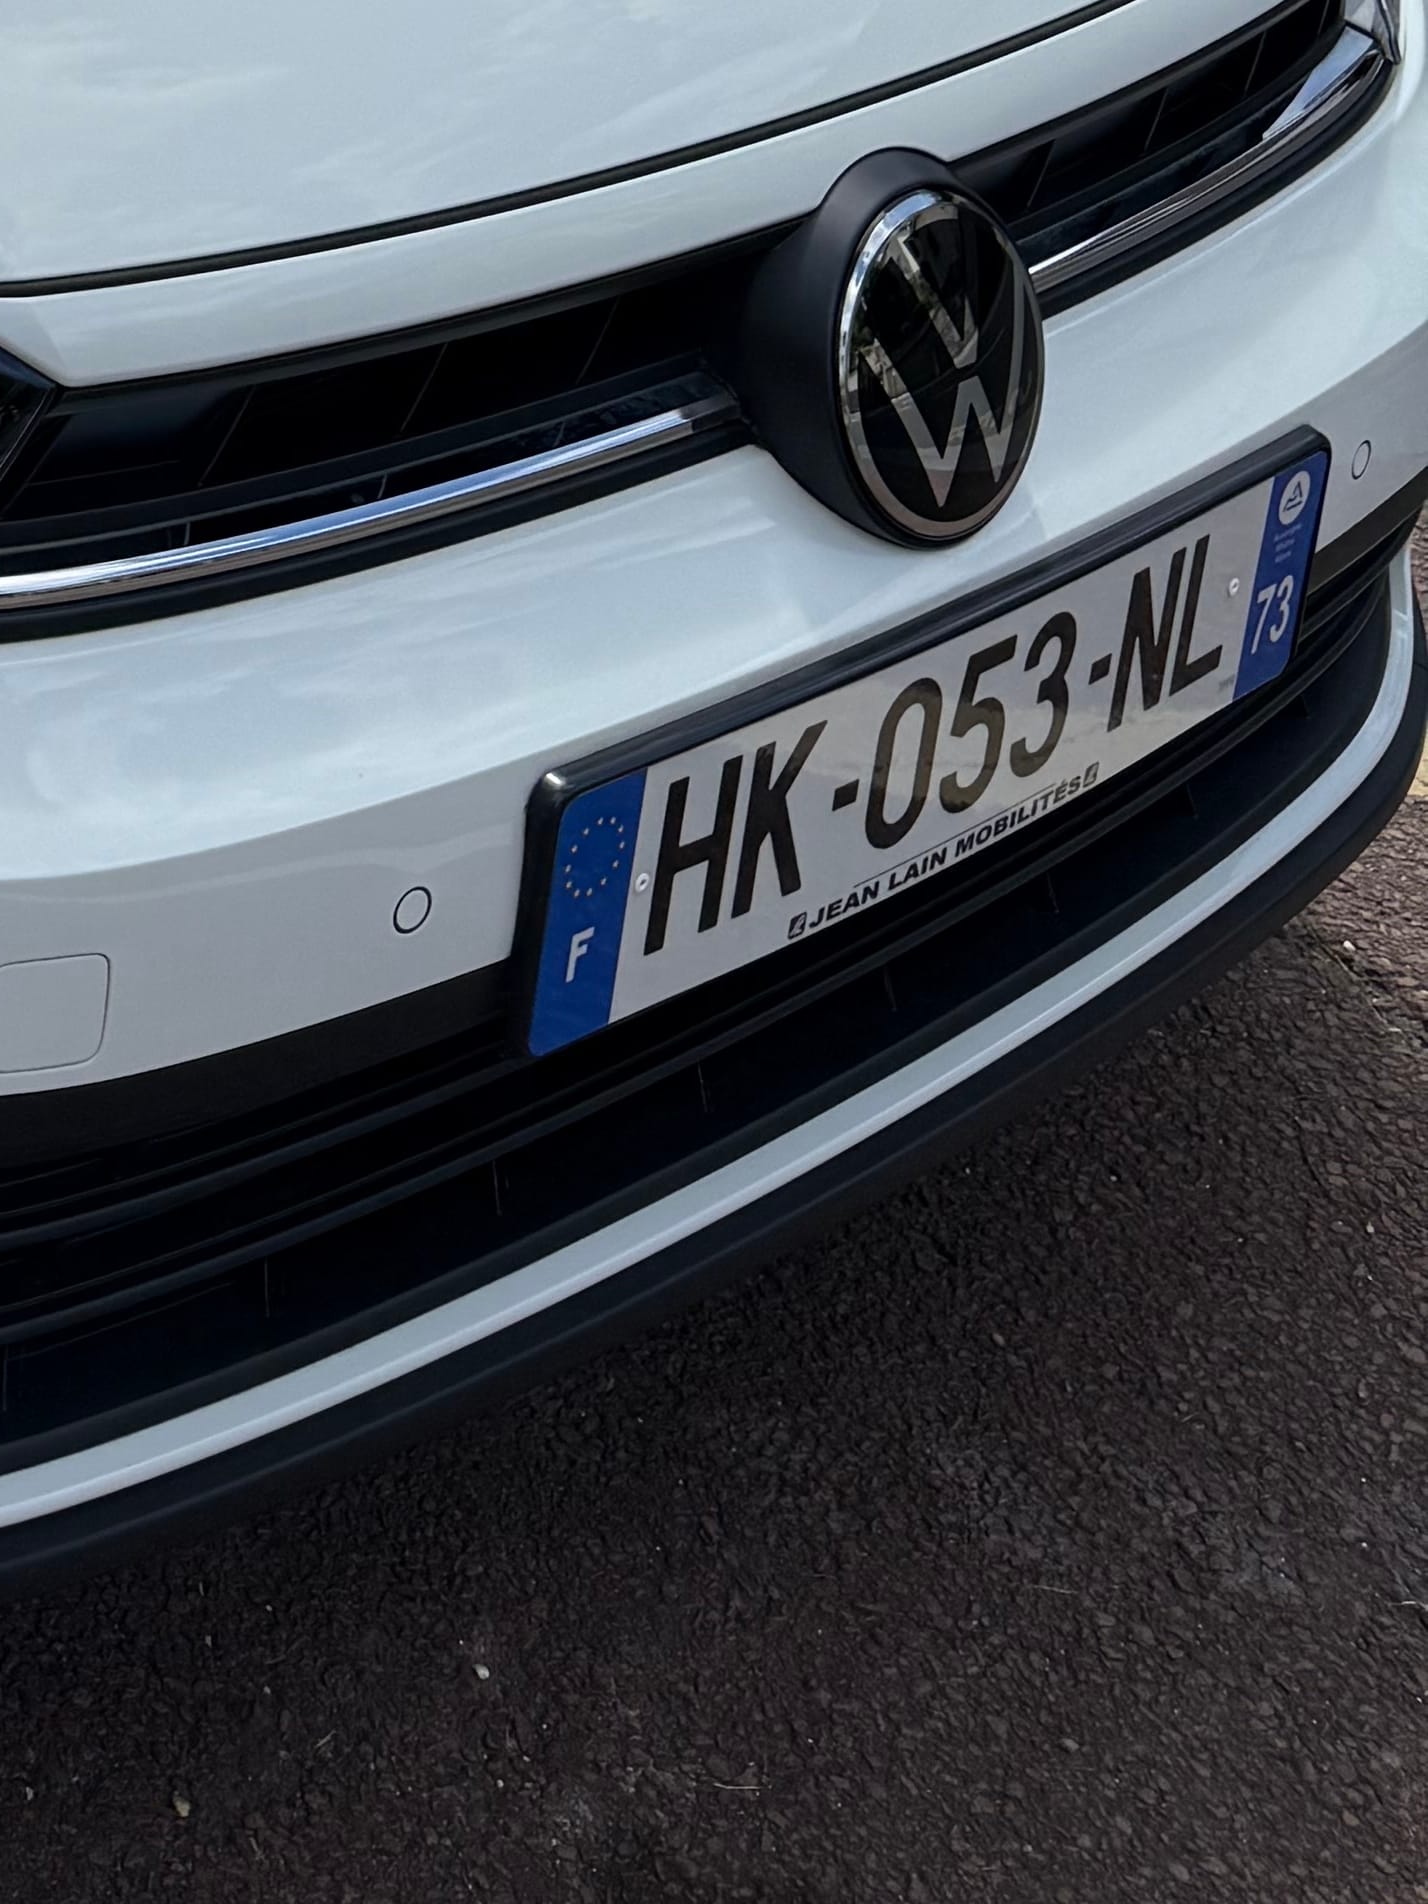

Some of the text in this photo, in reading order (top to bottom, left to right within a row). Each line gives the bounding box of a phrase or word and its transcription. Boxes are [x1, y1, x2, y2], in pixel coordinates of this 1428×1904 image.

[1251, 575, 1295, 654] 73
[645, 535, 1223, 955] HK-053-NL
[809, 778, 1081, 928] JEAN LAIN MOBILITÉS
[565, 926, 594, 982] F
